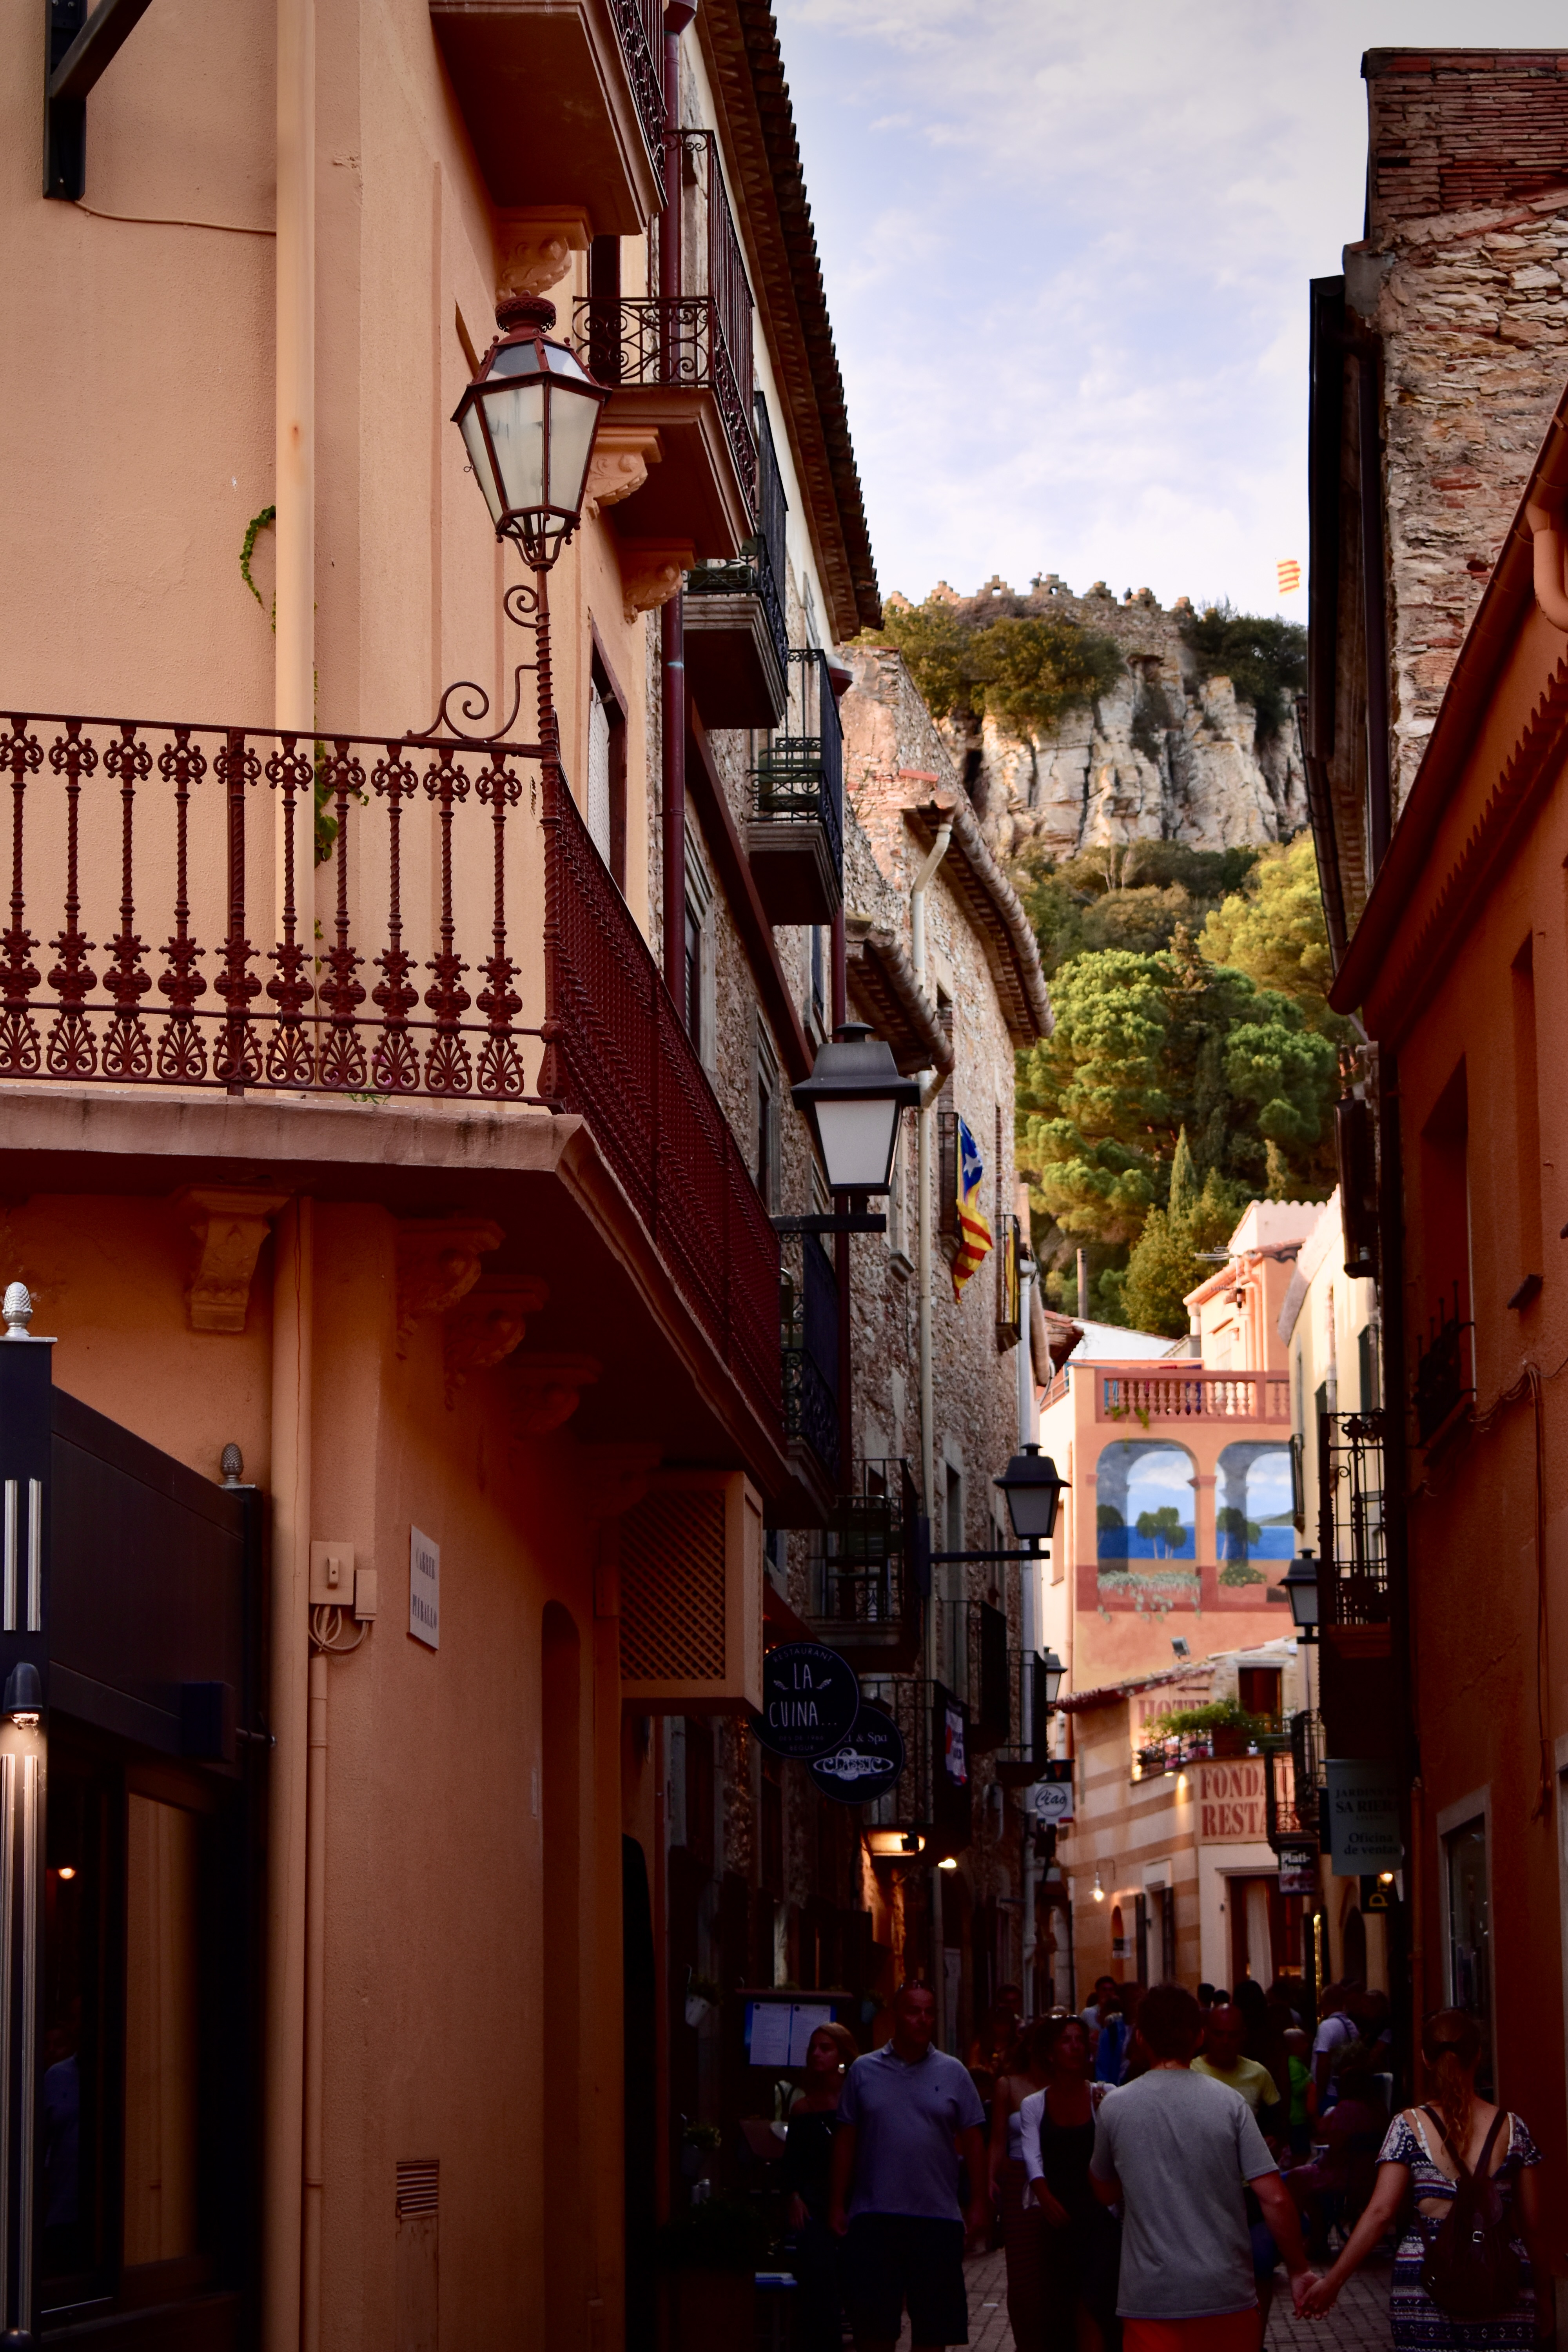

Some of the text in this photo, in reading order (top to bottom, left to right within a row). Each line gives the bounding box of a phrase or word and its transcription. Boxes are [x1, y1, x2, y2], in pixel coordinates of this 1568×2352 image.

[416, 1547, 435, 1580] CARRER
[772, 1647, 834, 1663] RESTAURANT
[793, 1662, 813, 1690] LA
[867, 1731, 887, 1745] Spa
[822, 1751, 883, 1773] CLASSIC
[1035, 1789, 1067, 1808] Ciao
[1335, 1788, 1383, 1798] JARDINS
[1336, 1801, 1354, 1813] SA
[1348, 1832, 1393, 1843] Oficina
[1344, 1844, 1399, 1855] de ventas
